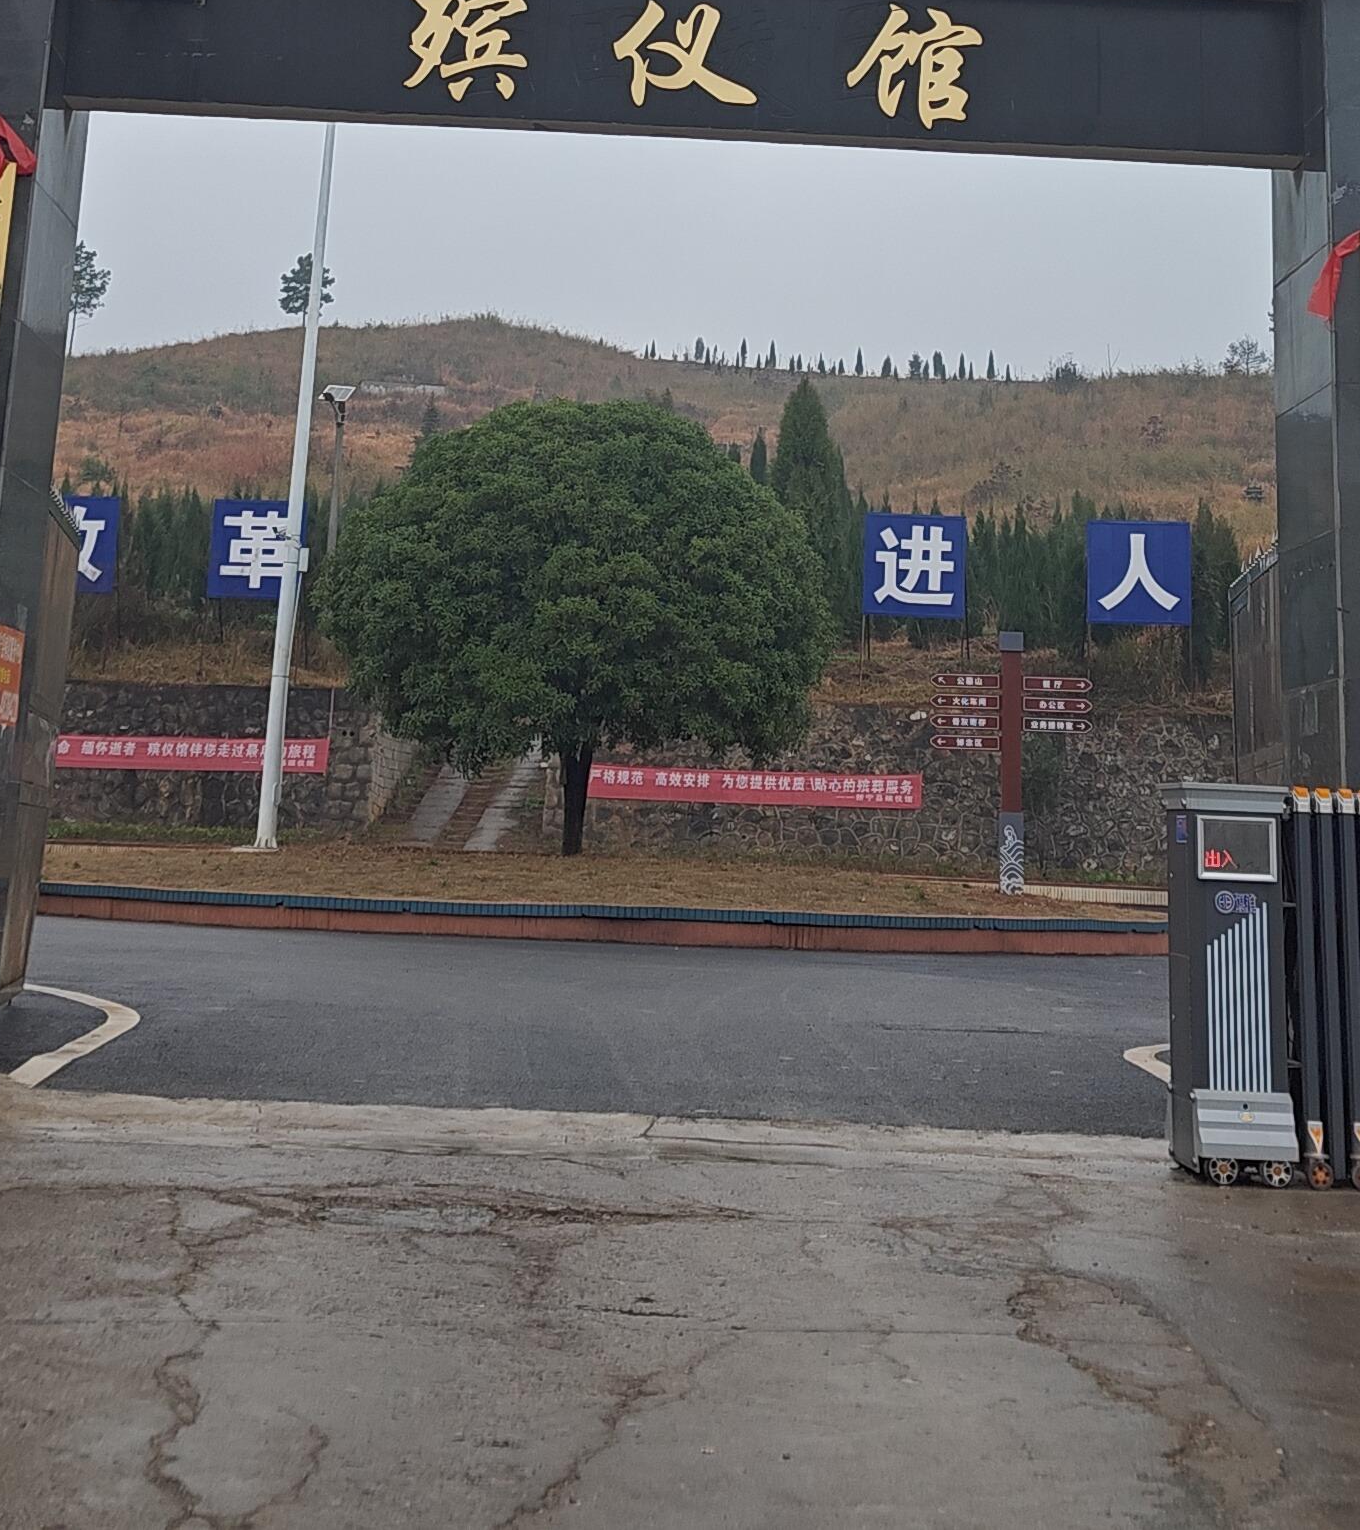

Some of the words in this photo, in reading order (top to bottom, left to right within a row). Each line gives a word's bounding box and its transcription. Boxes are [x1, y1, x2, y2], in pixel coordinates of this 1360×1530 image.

[219, 510, 292, 589] 革
[873, 525, 955, 606] 进
[1097, 533, 1181, 611] 人
[81, 741, 137, 757] 缅怀逝者
[147, 742, 317, 760] 殡仪馆伴您走过最旅程
[589, 769, 644, 786] 严格规范
[655, 772, 710, 788] 高效安排
